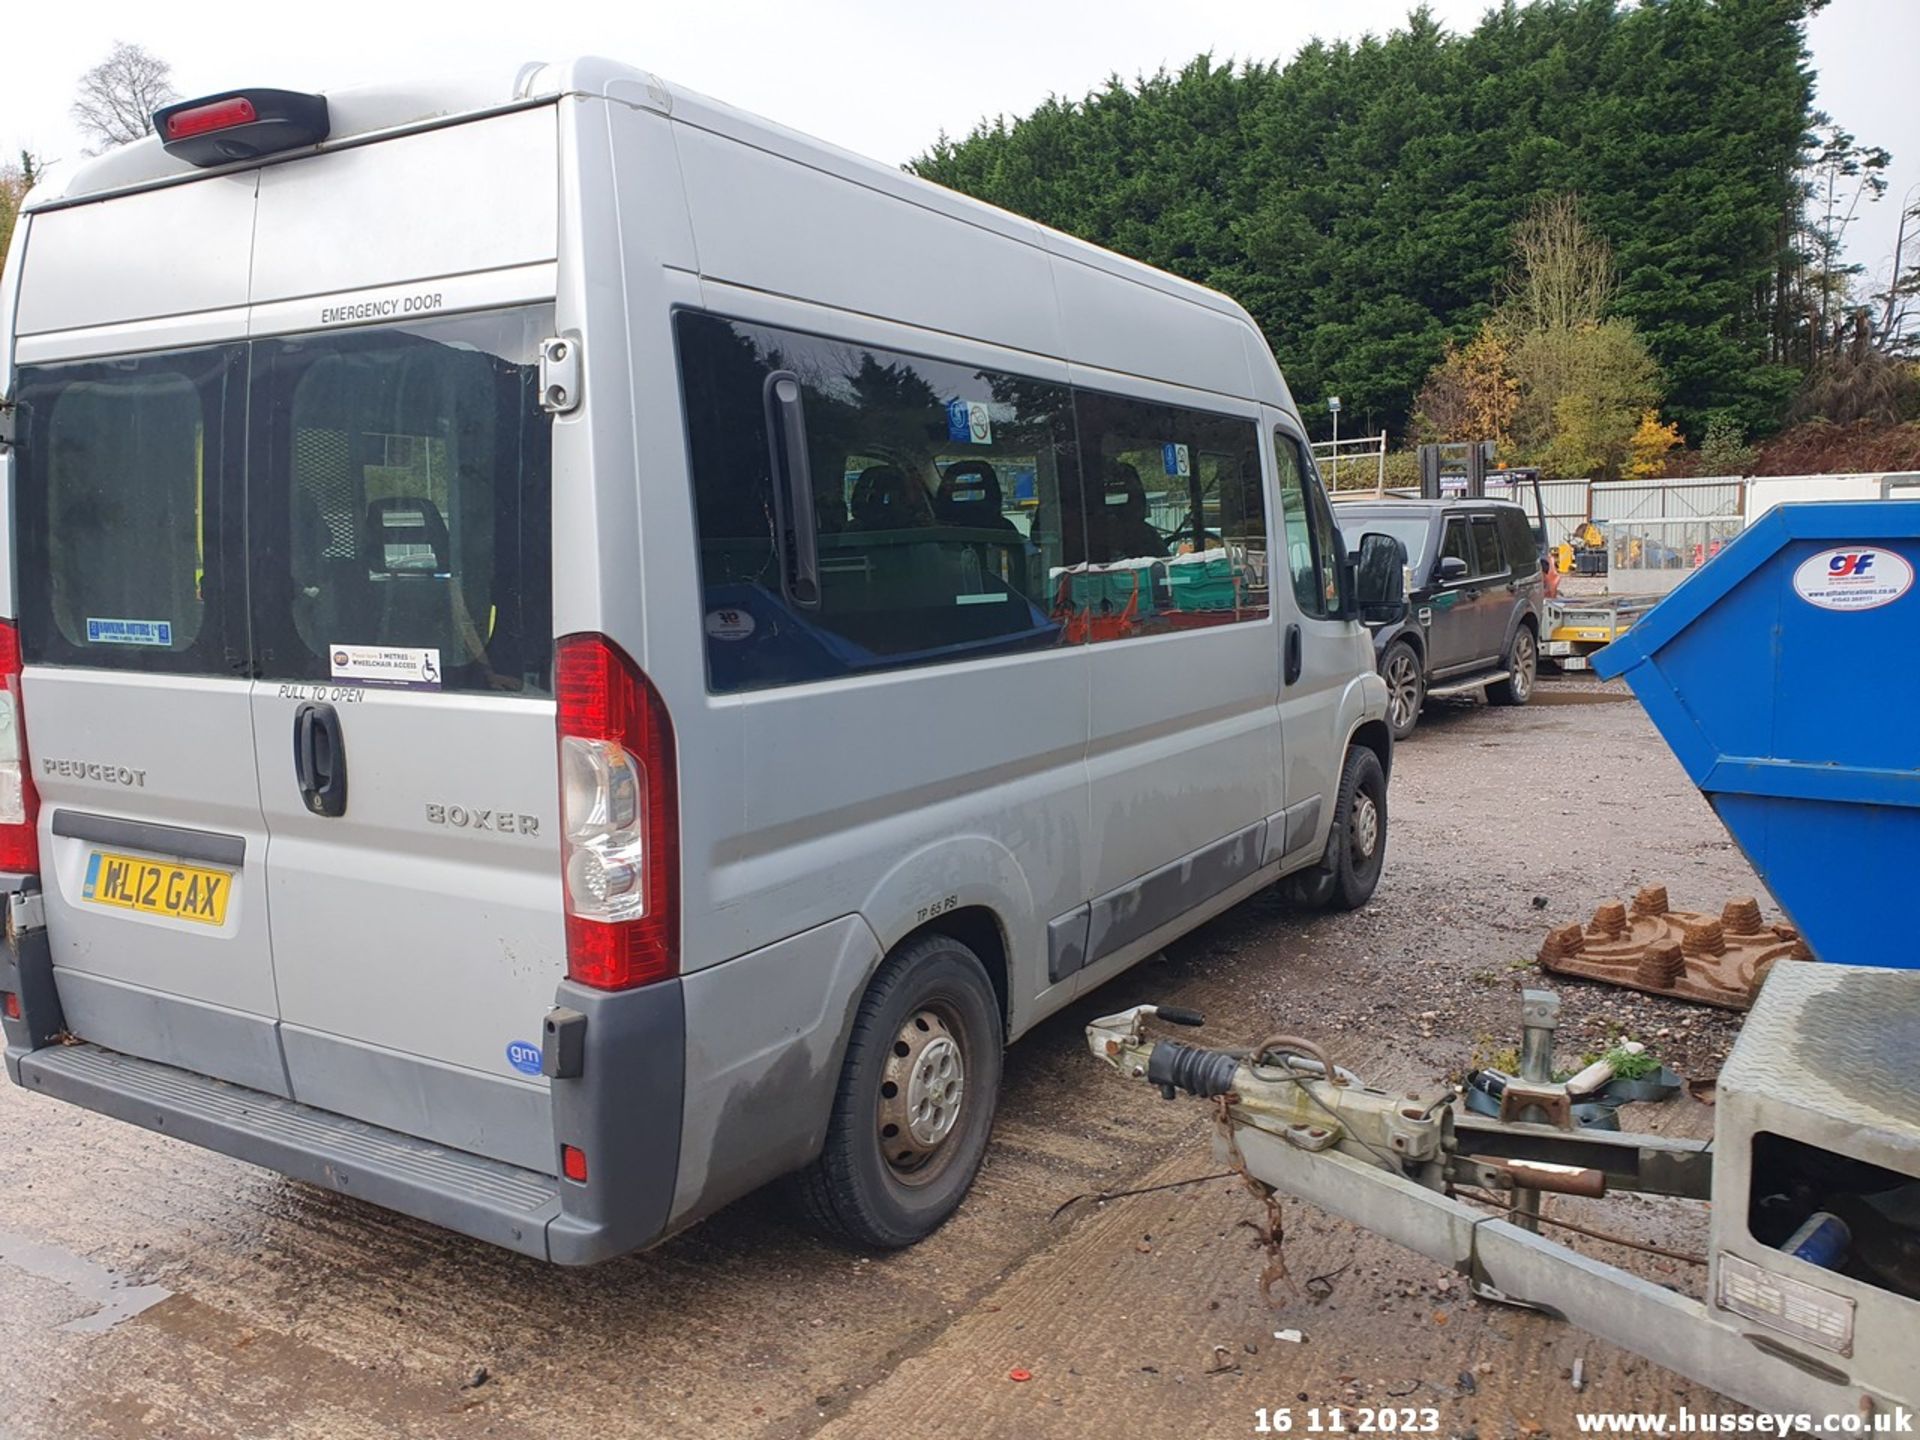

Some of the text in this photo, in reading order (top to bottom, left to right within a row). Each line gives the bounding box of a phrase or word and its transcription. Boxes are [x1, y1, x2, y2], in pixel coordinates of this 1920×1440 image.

[321, 293, 442, 323] EMERGENCY DOOR
[393, 662, 416, 670] ACCESS
[279, 685, 365, 702] PULL TO OPEN
[43, 758, 147, 787] PEUGEOT
[425, 802, 540, 836] BOXER
[165, 871, 221, 917] GAX
[917, 907, 928, 921] TP
[944, 894, 958, 910] PSI
[511, 1046, 539, 1063] gm
